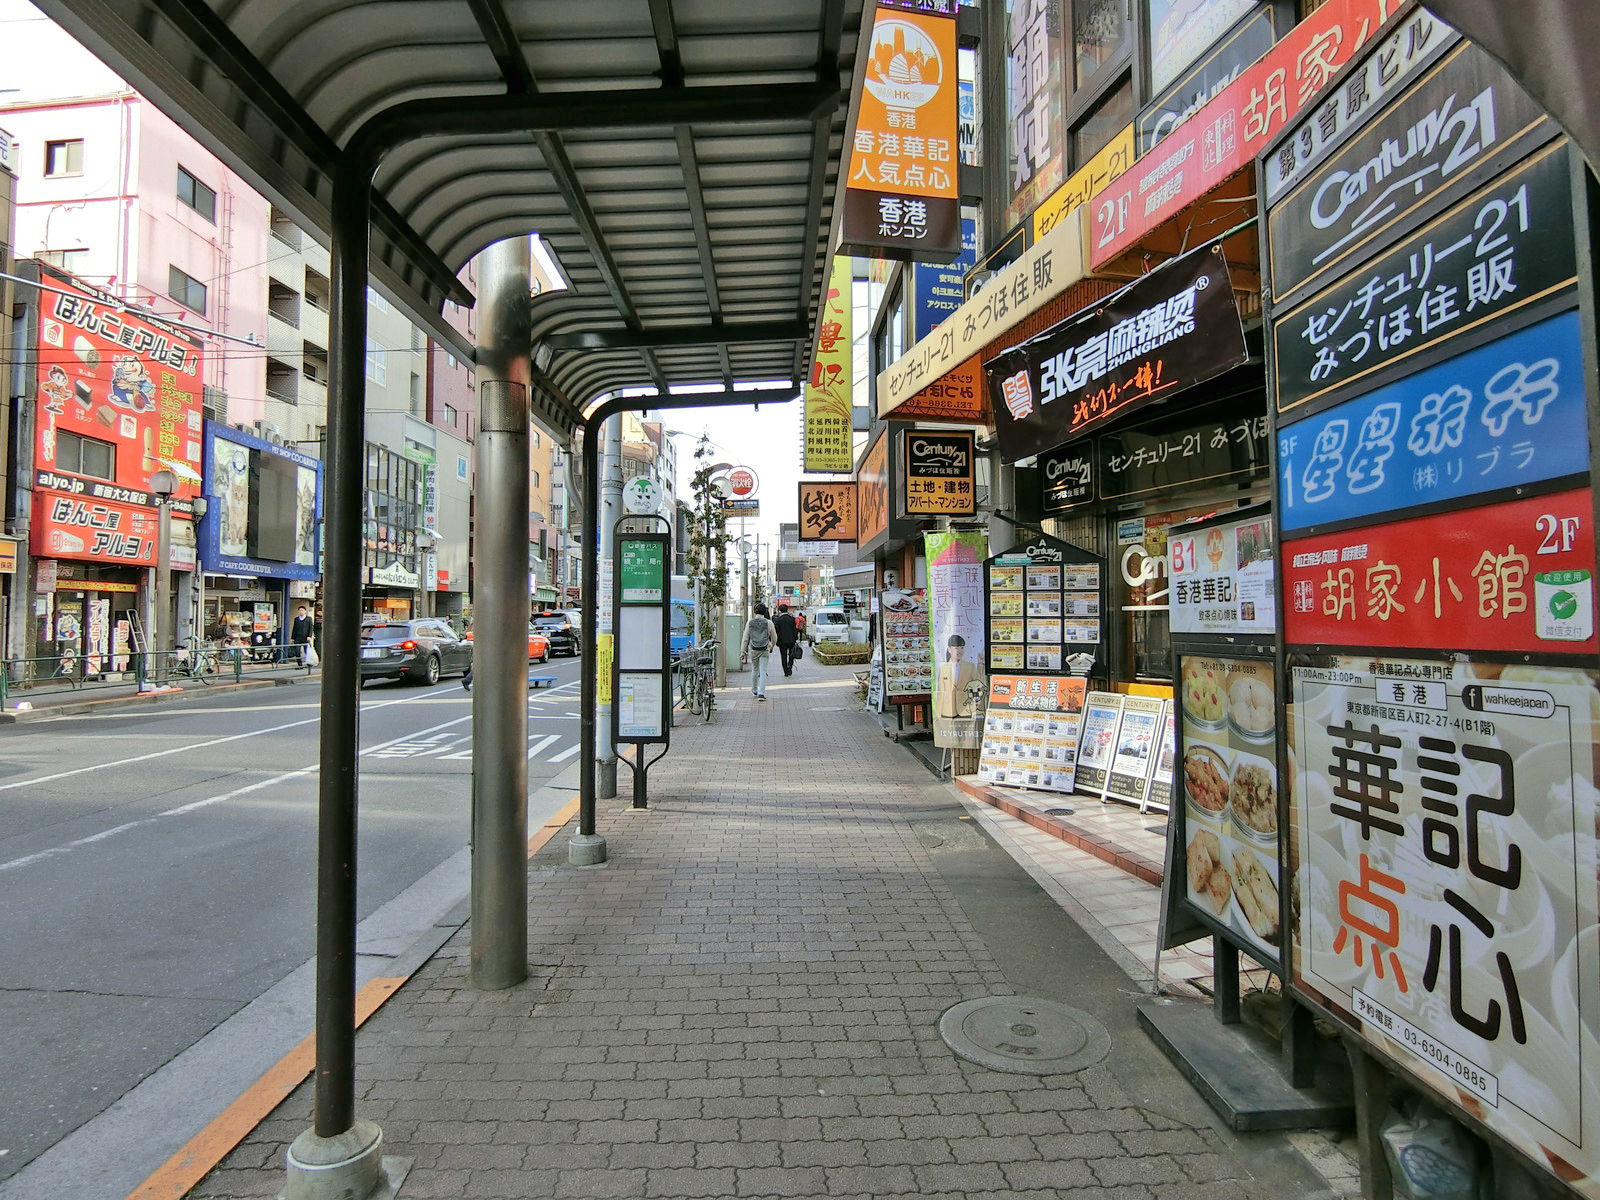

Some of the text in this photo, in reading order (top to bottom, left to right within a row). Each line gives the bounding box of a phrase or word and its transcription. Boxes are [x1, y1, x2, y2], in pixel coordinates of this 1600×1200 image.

[886, 111, 917, 130] 香港
[853, 130, 950, 162] 香港華記
[1309, 92, 1457, 230] Century
[1438, 85, 1497, 178] 21
[853, 158, 951, 189] 人気点心
[879, 198, 927, 226] 香港
[1097, 189, 1132, 250] 2F
[878, 223, 928, 239] ホンコン
[1301, 183, 1530, 346] センチュリー21
[889, 327, 955, 397] センチュリー21
[962, 248, 1053, 343] みづほ住販
[1309, 246, 1518, 382] みづほ住販
[1106, 321, 1196, 372] ZHANGLIANG
[912, 439, 967, 467] Century 21
[1107, 431, 1201, 474] センチュリー21
[1280, 434, 1298, 458] 3F
[38, 474, 85, 494] alyo.jp
[1045, 457, 1091, 484] Century 21
[909, 480, 970, 494] 土地・建物
[51, 497, 122, 531] はんこ屋
[908, 496, 972, 509] アパート・マンション
[1534, 513, 1580, 555] 2F
[1025, 546, 1062, 562] Century 21
[1172, 537, 1196, 573] B1
[1319, 544, 1530, 622] 胡家小館
[1368, 662, 1453, 681] 香港華記点心専門店
[1016, 680, 1059, 695] 新生活
[1090, 696, 1113, 704] CENTURY
[1391, 683, 1428, 706] 香港
[1009, 694, 1059, 711] オススメ物件
[1126, 700, 1153, 709] CENTURY
[1484, 693, 1550, 711] wahkeejapan
[1326, 719, 1522, 891] 華記
[1332, 852, 1528, 1046] 点心
[1403, 1026, 1487, 1092] 03-6304-0885
